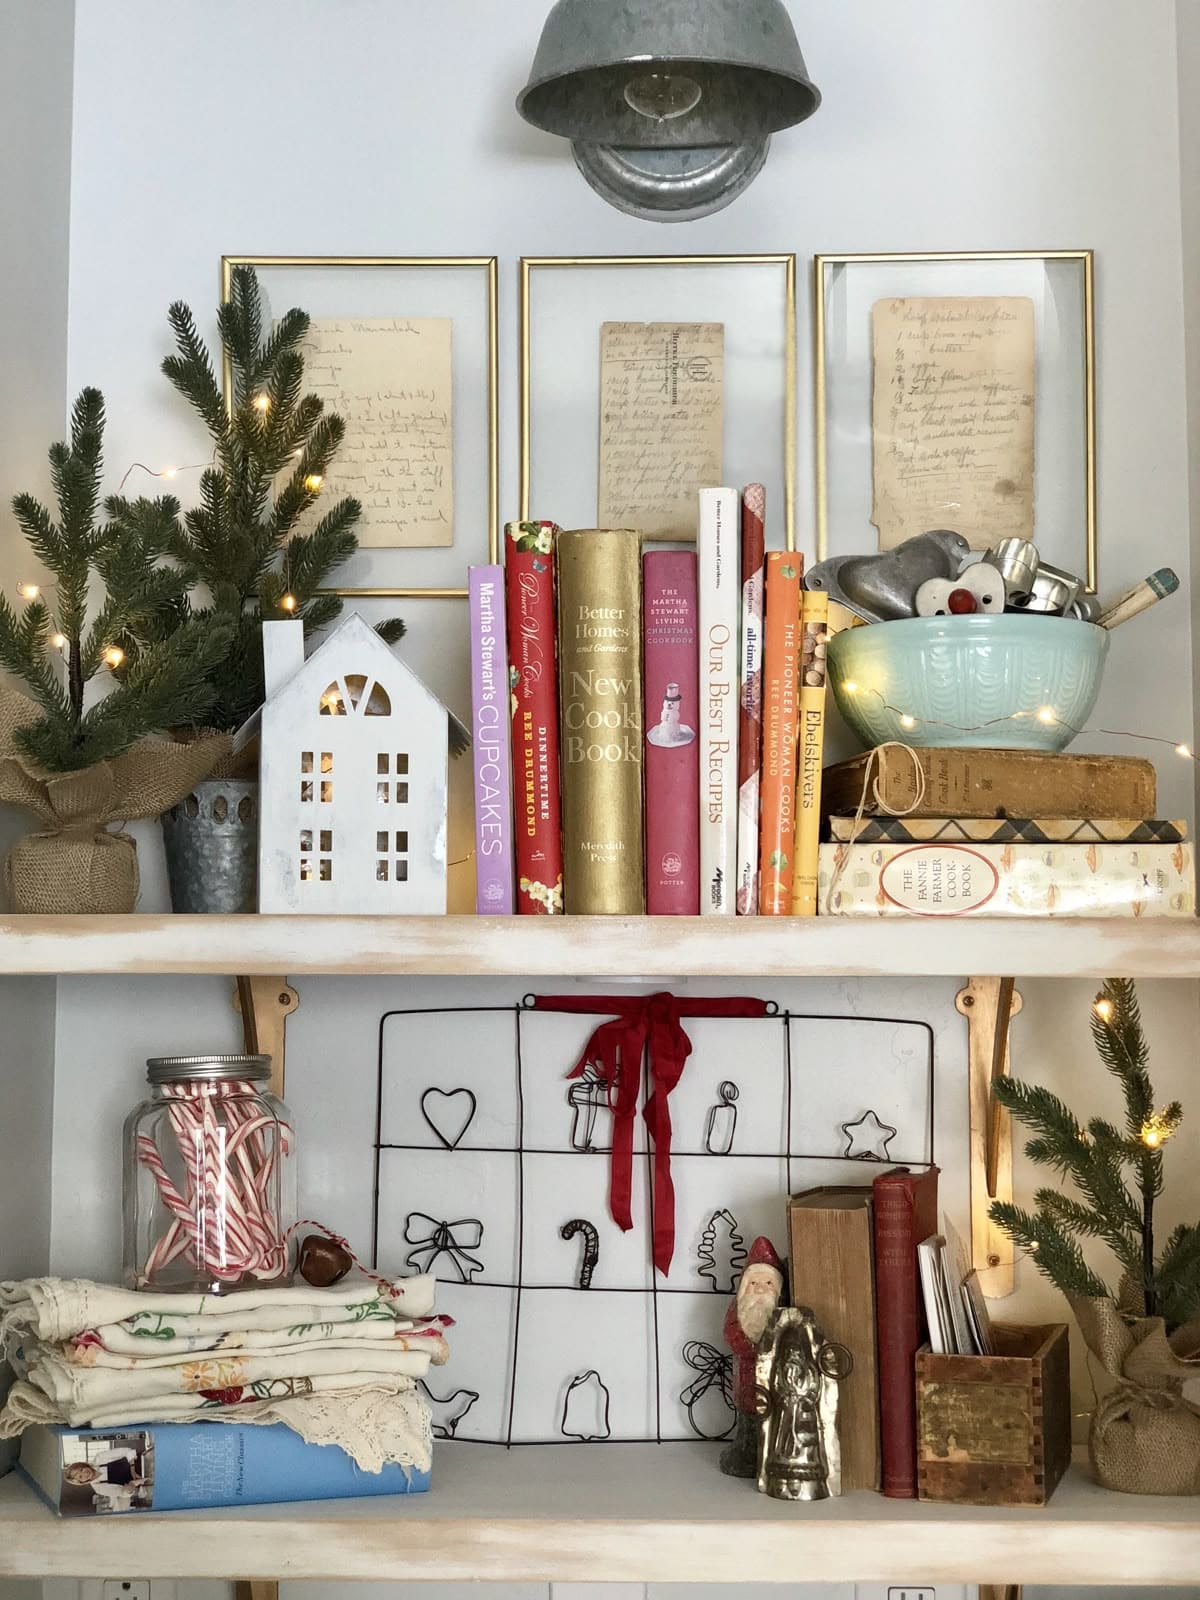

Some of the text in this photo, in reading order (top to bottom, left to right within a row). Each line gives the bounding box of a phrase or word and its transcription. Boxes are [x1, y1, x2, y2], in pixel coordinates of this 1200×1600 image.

[575, 624, 630, 639] Homes
[577, 605, 626, 621] Better
[518, 572, 544, 699] Pioneer Woman Cooks
[575, 643, 629, 654] and Gardens
[646, 637, 694, 645] COOKBOOK
[746, 626, 757, 669] all-time
[569, 669, 633, 698] New
[478, 582, 503, 856] Martha Stewart's CUPCAKES
[565, 702, 640, 730] Cook
[708, 623, 731, 825] OUR BEST RECIPES
[769, 679, 779, 777] REE DRUMMOND
[781, 623, 794, 834] THE PIONEER WOMAN COOKS
[567, 735, 641, 763] Book
[803, 709, 822, 809] Ebelskivers
[523, 711, 536, 837] REE DRUMMOND
[538, 726, 550, 820] DINNERTIME
[580, 840, 625, 851] Meredith
[590, 853, 618, 863] Press
[903, 868, 913, 893] THE
[917, 859, 928, 901] FANNIE
[932, 857, 942, 903] FARMER
[961, 864, 972, 897] BOOK
